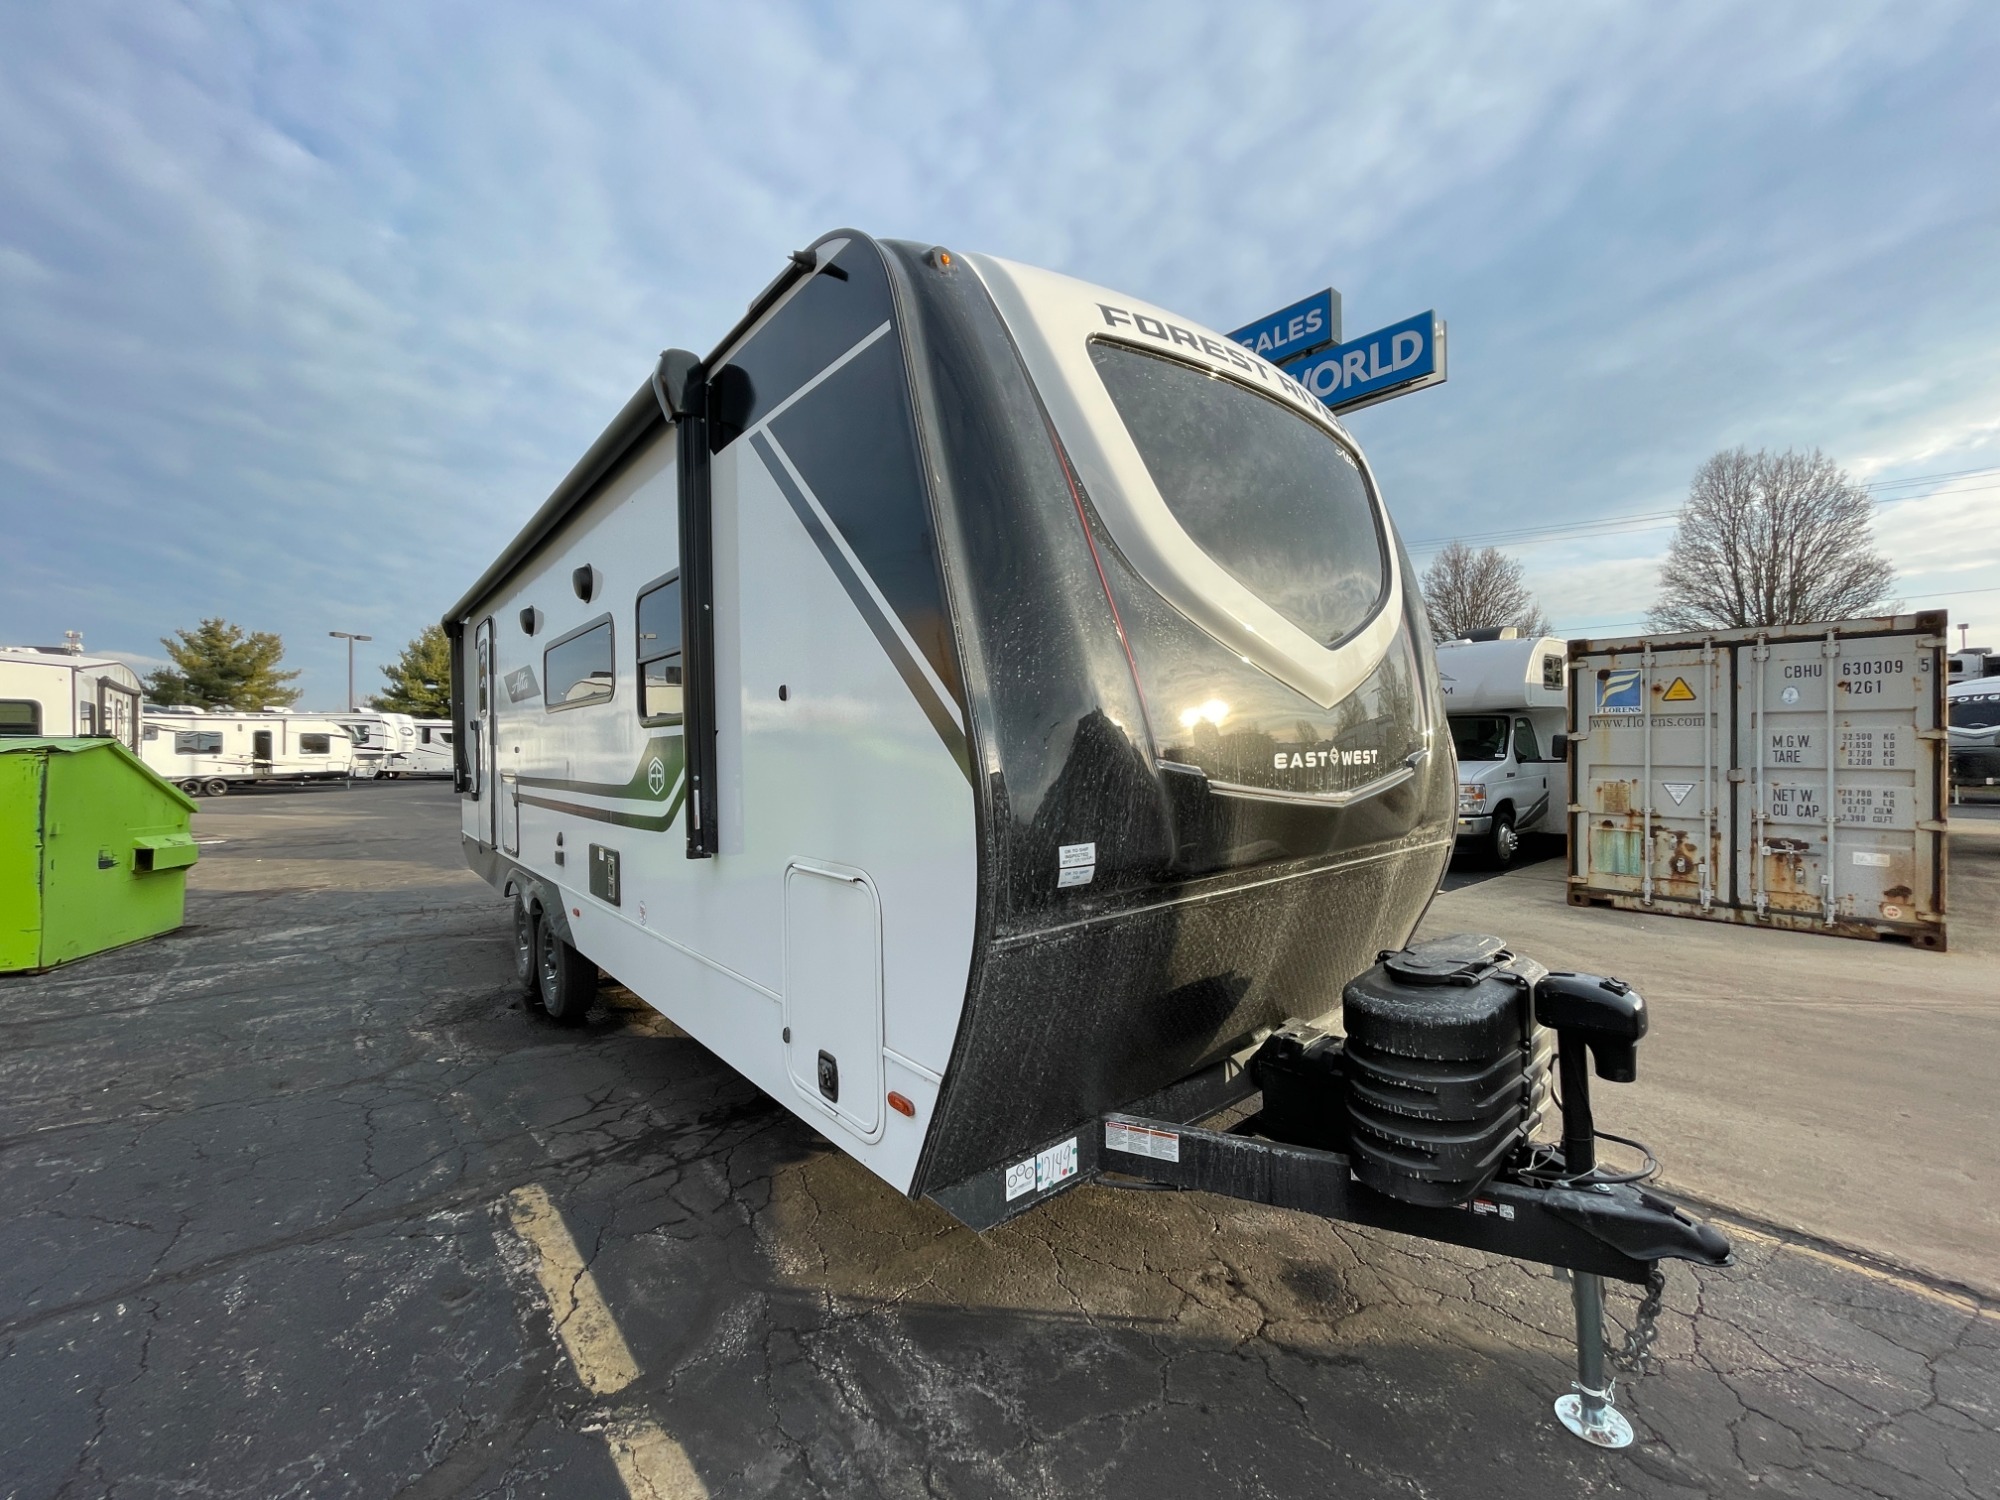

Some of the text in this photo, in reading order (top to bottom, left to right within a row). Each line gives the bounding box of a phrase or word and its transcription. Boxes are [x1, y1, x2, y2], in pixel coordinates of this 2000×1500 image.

[1095, 303, 1268, 380] FOREST
[1784, 658, 1929, 679] CBHU 630309 5
[1592, 716, 1705, 728] www.floens.com
[1274, 750, 1377, 769] EAST WEST
[1772, 750, 1801, 763] TARE
[1773, 789, 1796, 801] NET
[1796, 804, 1819, 818] CAP
